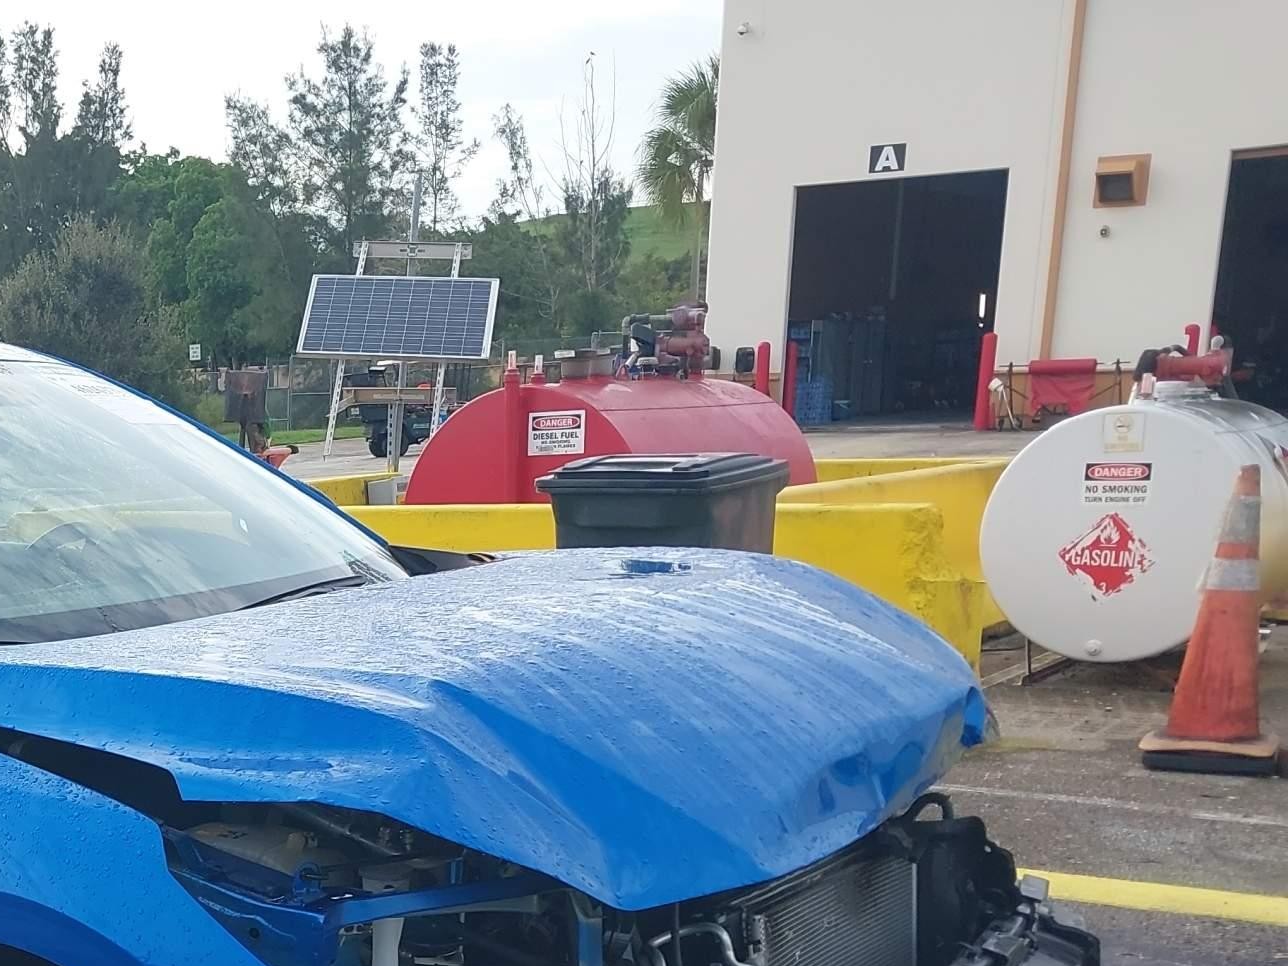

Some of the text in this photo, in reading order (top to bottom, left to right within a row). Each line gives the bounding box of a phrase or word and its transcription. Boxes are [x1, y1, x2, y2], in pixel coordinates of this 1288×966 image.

[875, 146, 899, 171] A
[540, 418, 573, 427] DANGER
[533, 432, 559, 440] DIESEL
[1093, 467, 1143, 477] DANGER
[1085, 485, 1148, 494] NO SMOKING
